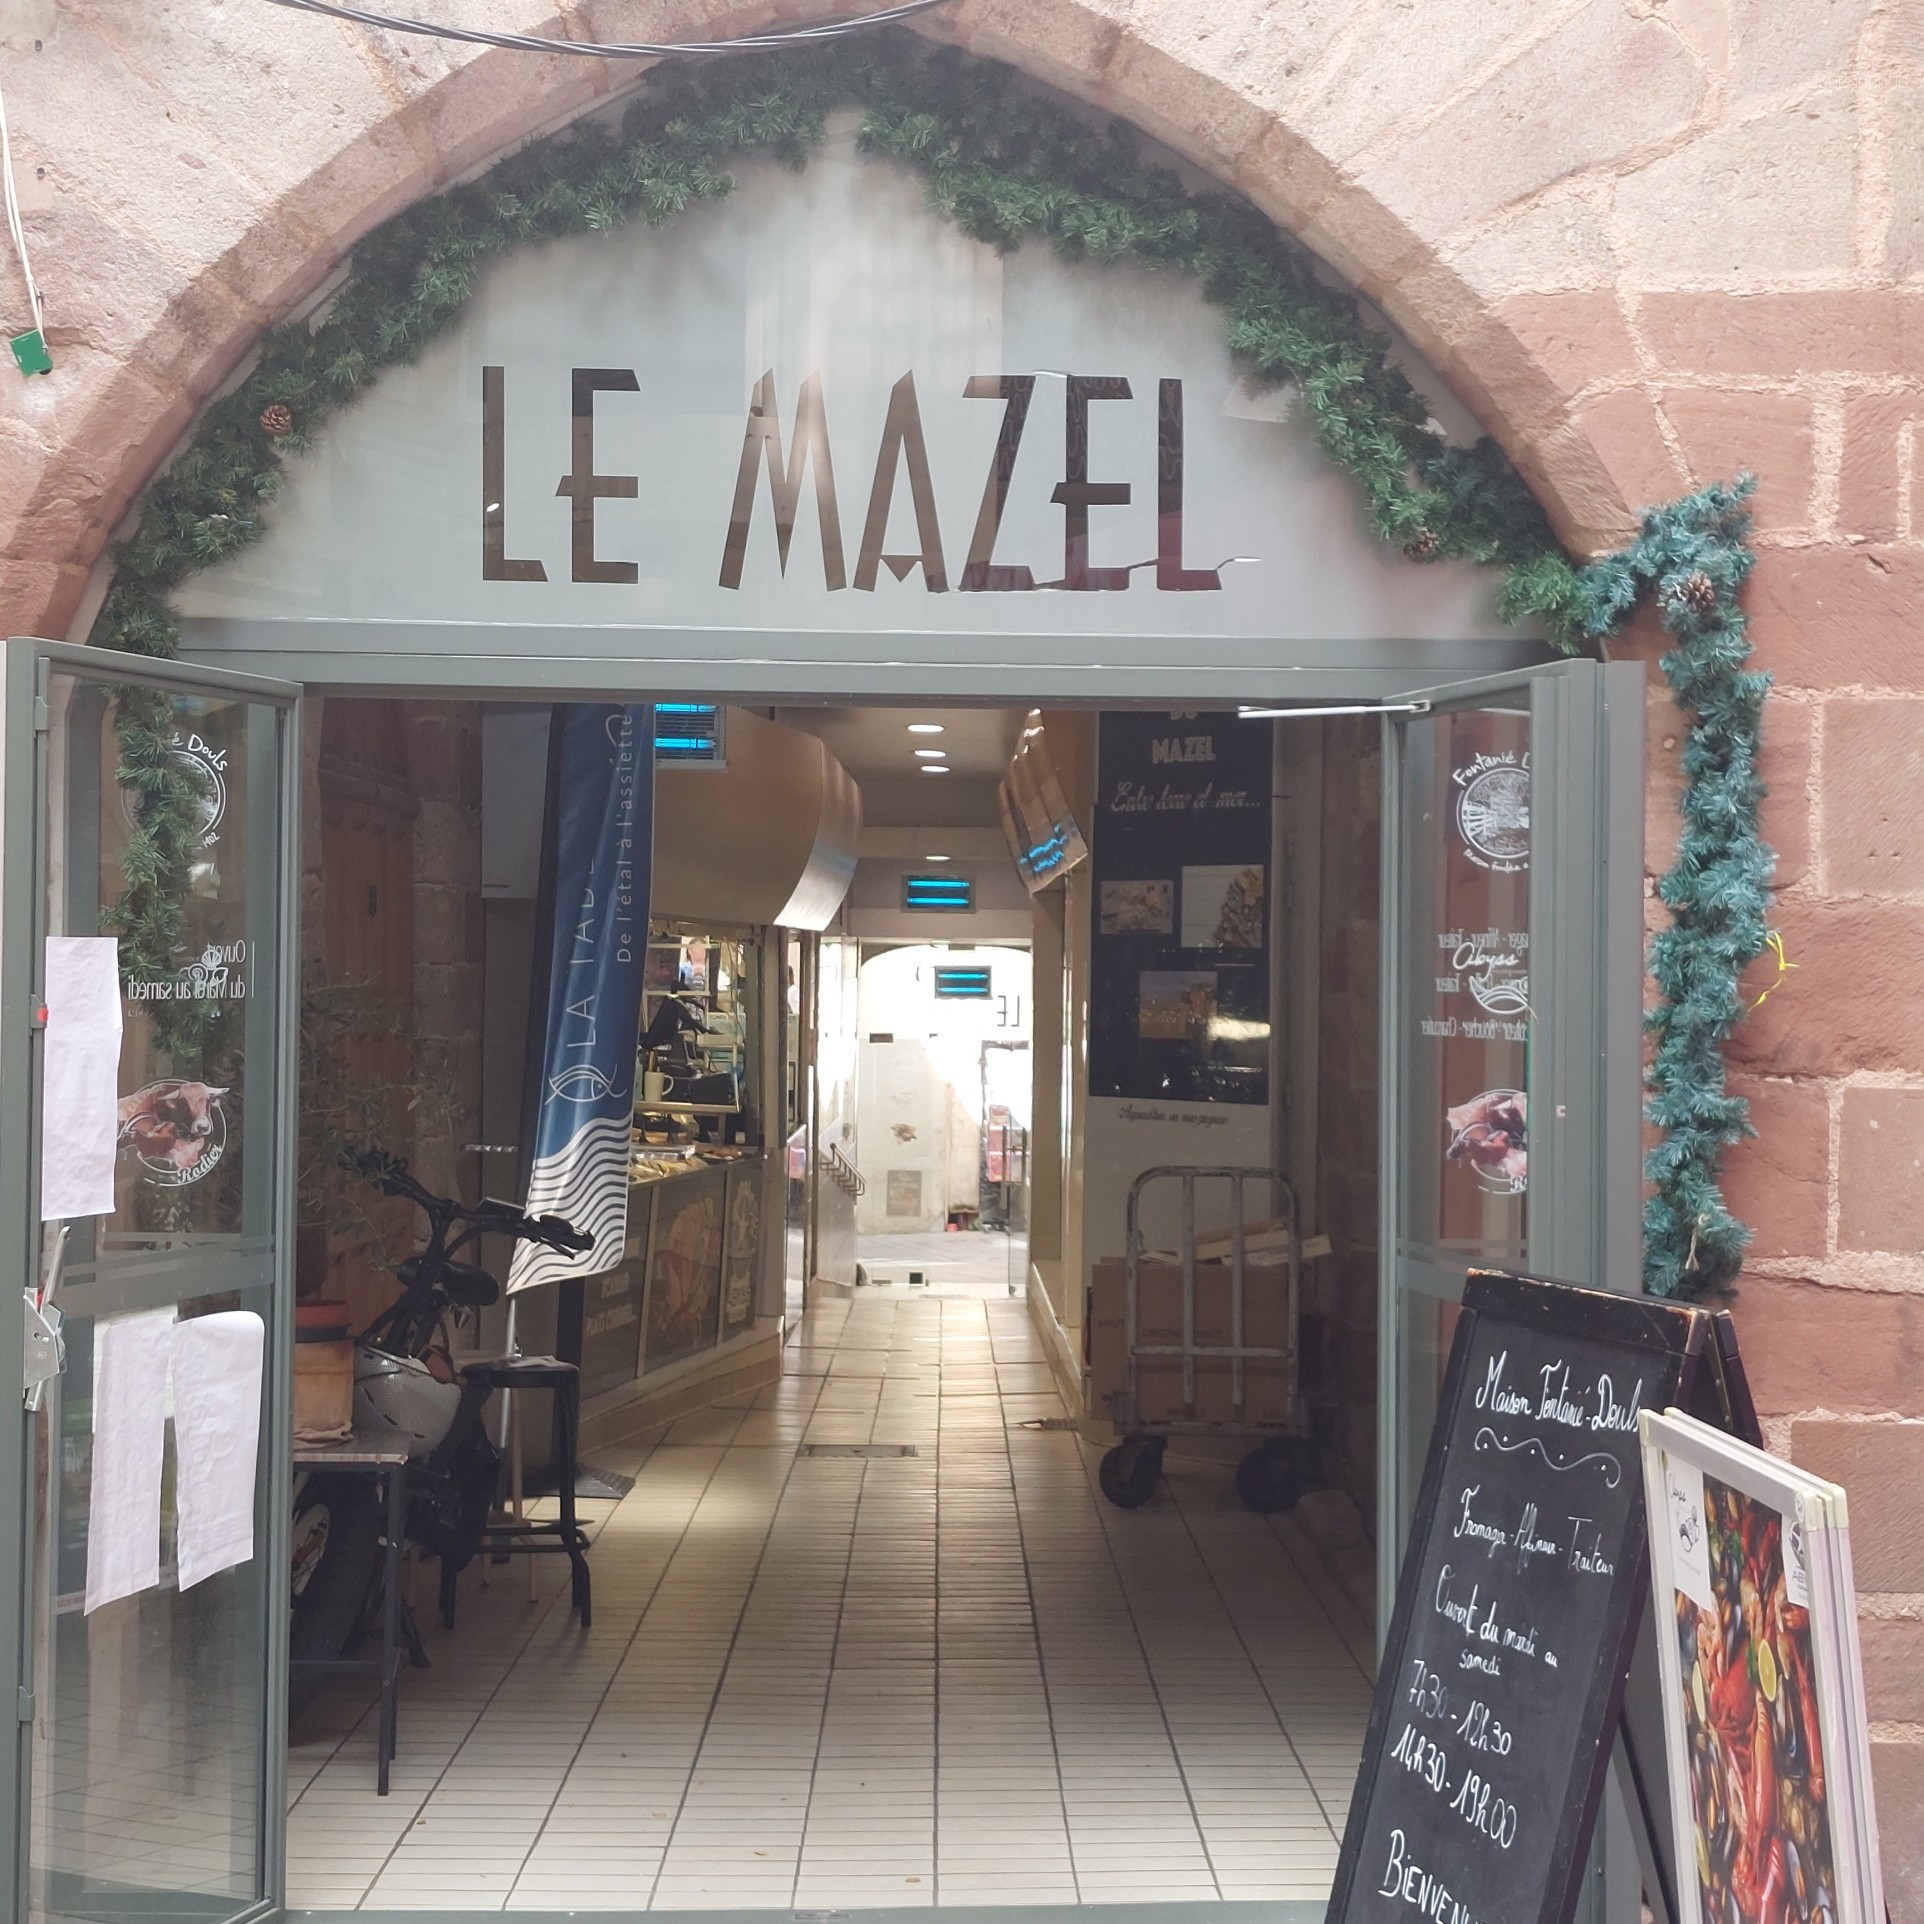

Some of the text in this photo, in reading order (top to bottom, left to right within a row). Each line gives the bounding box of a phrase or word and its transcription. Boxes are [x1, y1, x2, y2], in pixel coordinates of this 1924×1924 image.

[483, 366, 1223, 593] LE MAZEL
[187, 733, 228, 773] Douls
[1151, 735, 1217, 764] MAZEL
[1452, 749, 1518, 786] Fontanié
[614, 714, 633, 963] De l'étal à l'assiette
[566, 994, 597, 1049] LA
[177, 1143, 223, 1184] Rodier
[1475, 1350, 1532, 1415] Maison
[1435, 1564, 1559, 1668] Ouvert du mardi au
[1459, 1648, 1503, 1676] samedi
